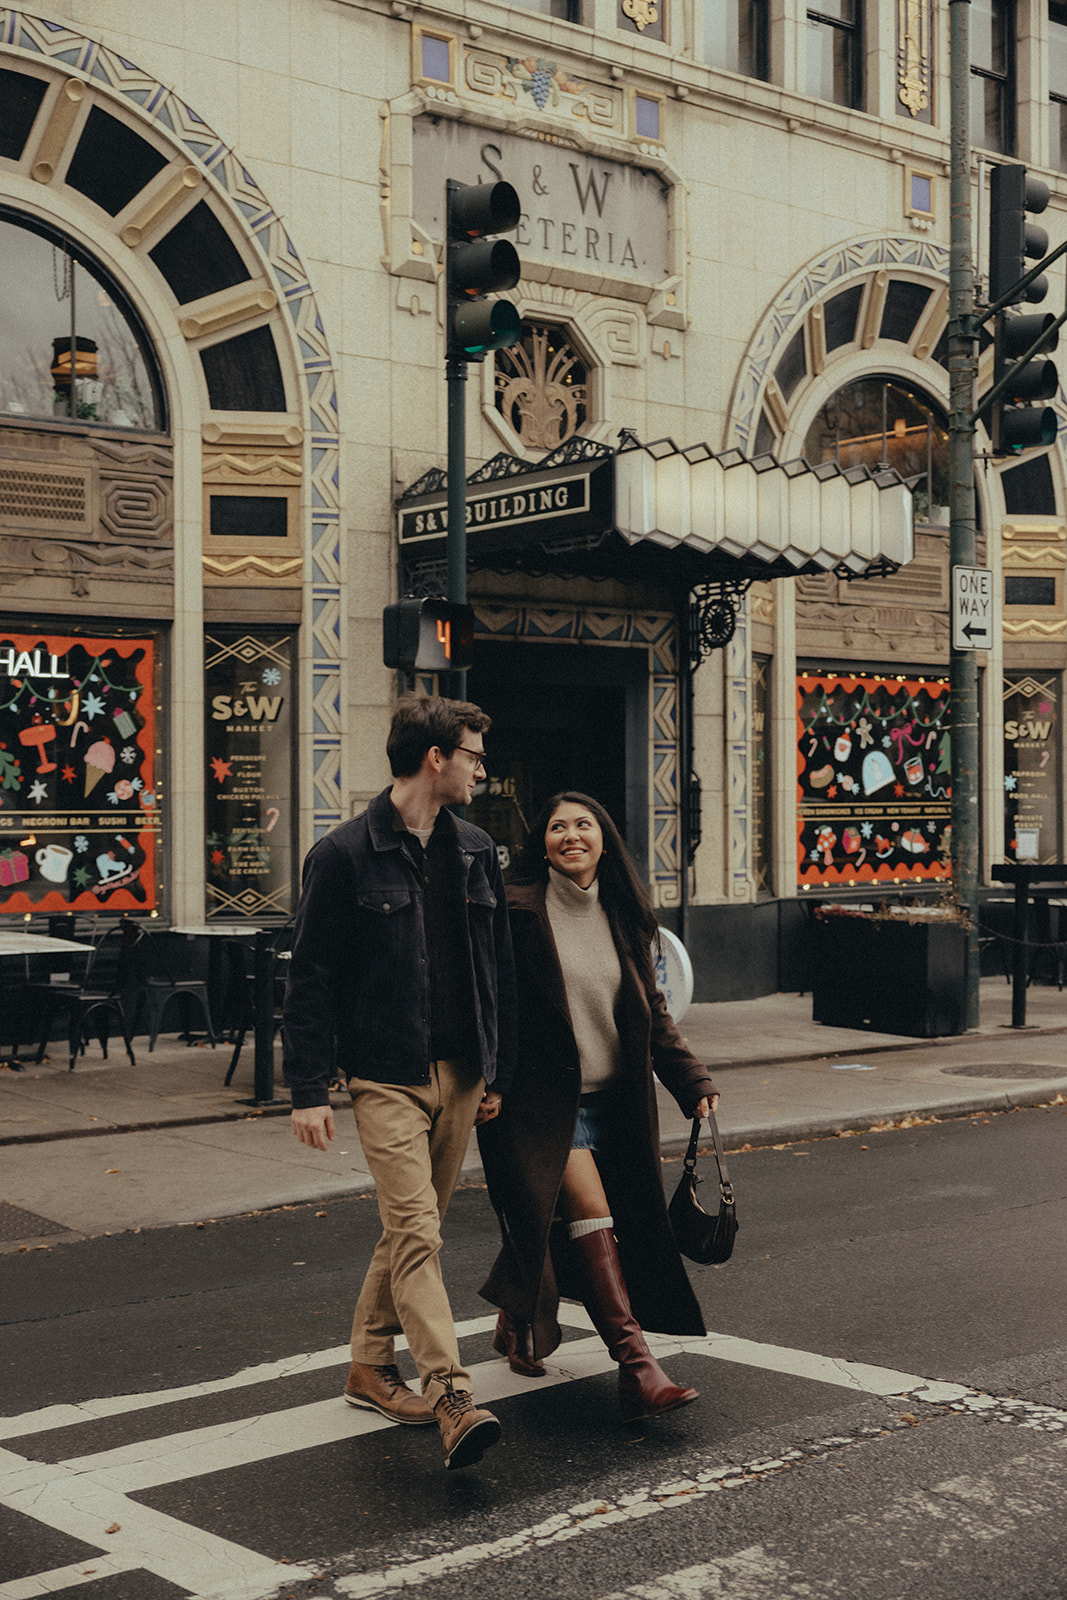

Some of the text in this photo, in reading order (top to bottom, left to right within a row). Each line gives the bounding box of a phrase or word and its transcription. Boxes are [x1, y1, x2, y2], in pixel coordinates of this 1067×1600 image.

[532, 164, 549, 197] &
[568, 162, 613, 218] W
[492, 212, 647, 269] ETERIA.
[959, 574, 989, 595] ONE
[959, 597, 990, 617] WAY
[436, 619, 451, 660] 4
[0, 648, 70, 679] HALL
[211, 694, 283, 722] S&W
[225, 725, 273, 733] MARKET
[1003, 720, 1052, 741] S&W
[22, 817, 68, 827] NEGRONI
[69, 817, 91, 826] BAR
[98, 816, 127, 826] SUSHI
